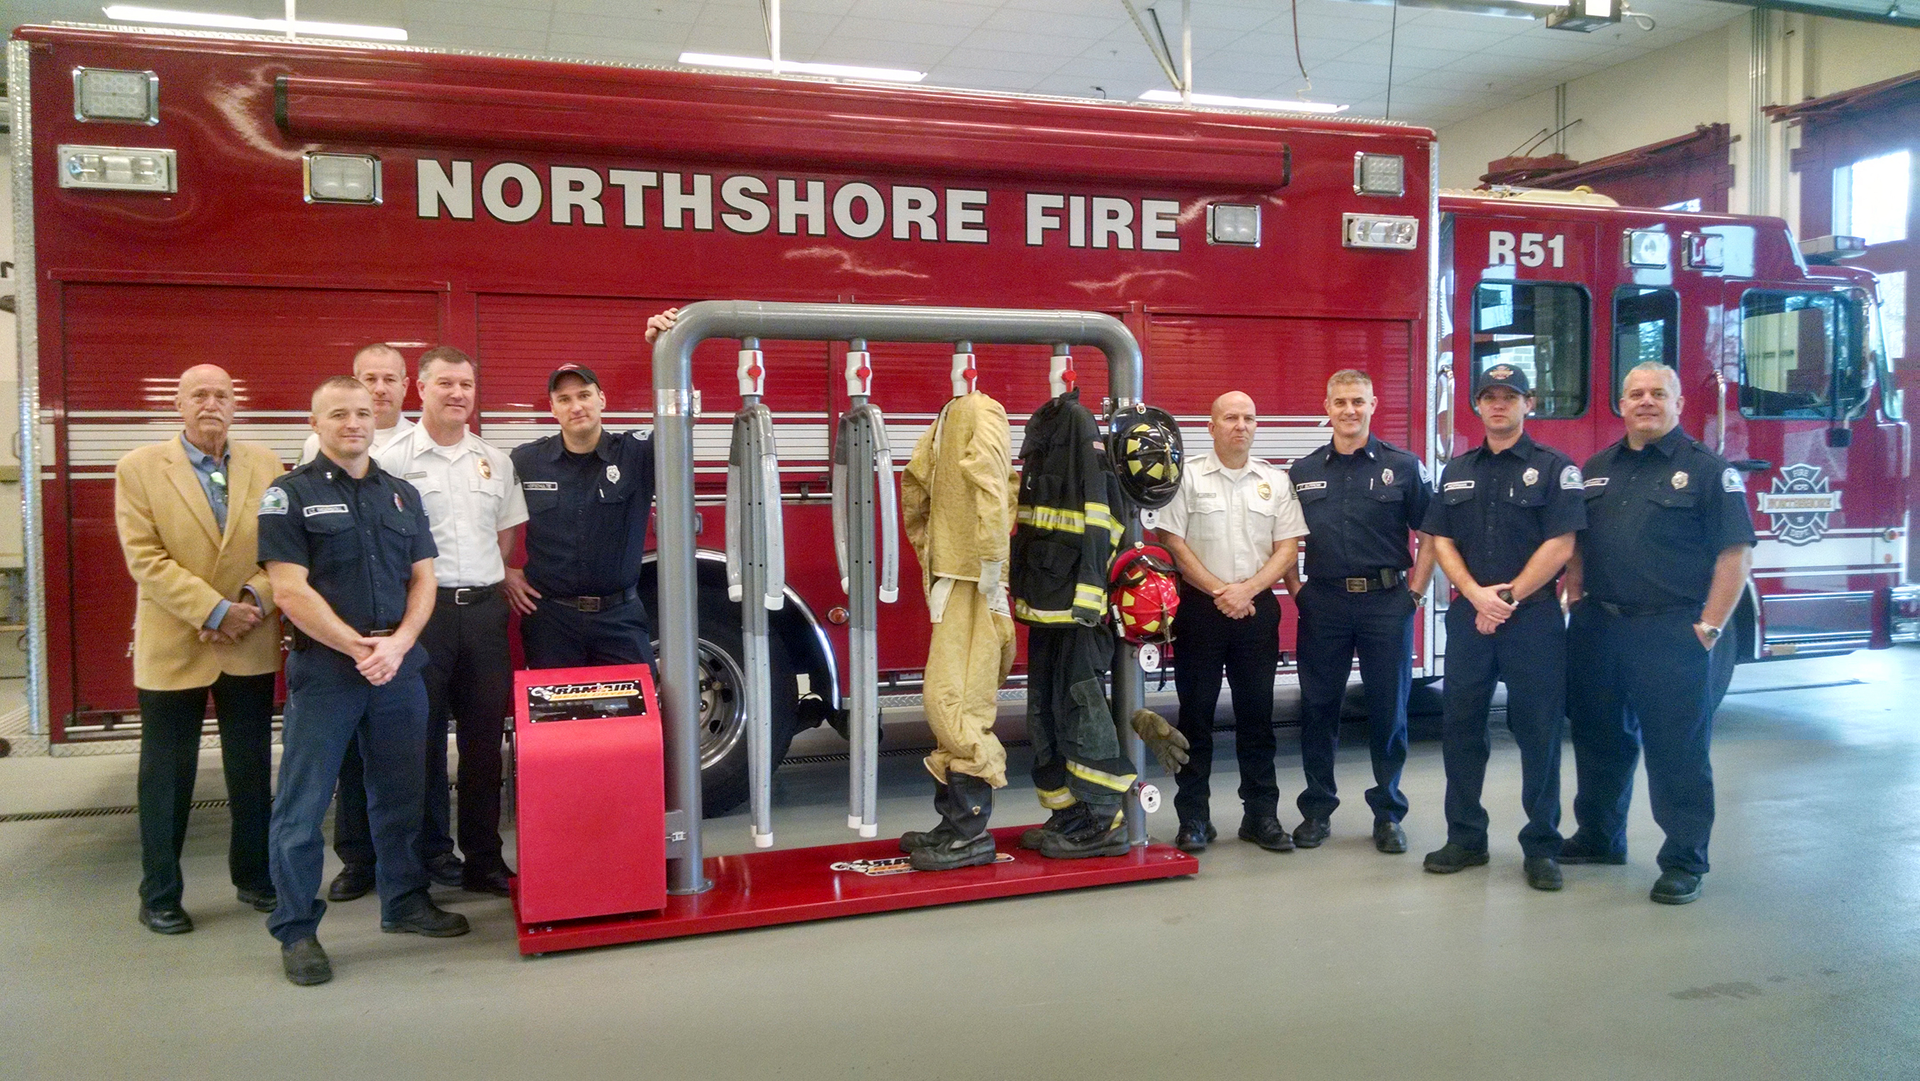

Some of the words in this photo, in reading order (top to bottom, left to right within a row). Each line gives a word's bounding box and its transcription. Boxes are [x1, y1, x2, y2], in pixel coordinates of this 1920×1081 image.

[415, 157, 990, 243] NORTHSHORE
[1025, 192, 1181, 252] FIRE
[1488, 230, 1564, 268] R51
[1793, 468, 1809, 477] FIRE
